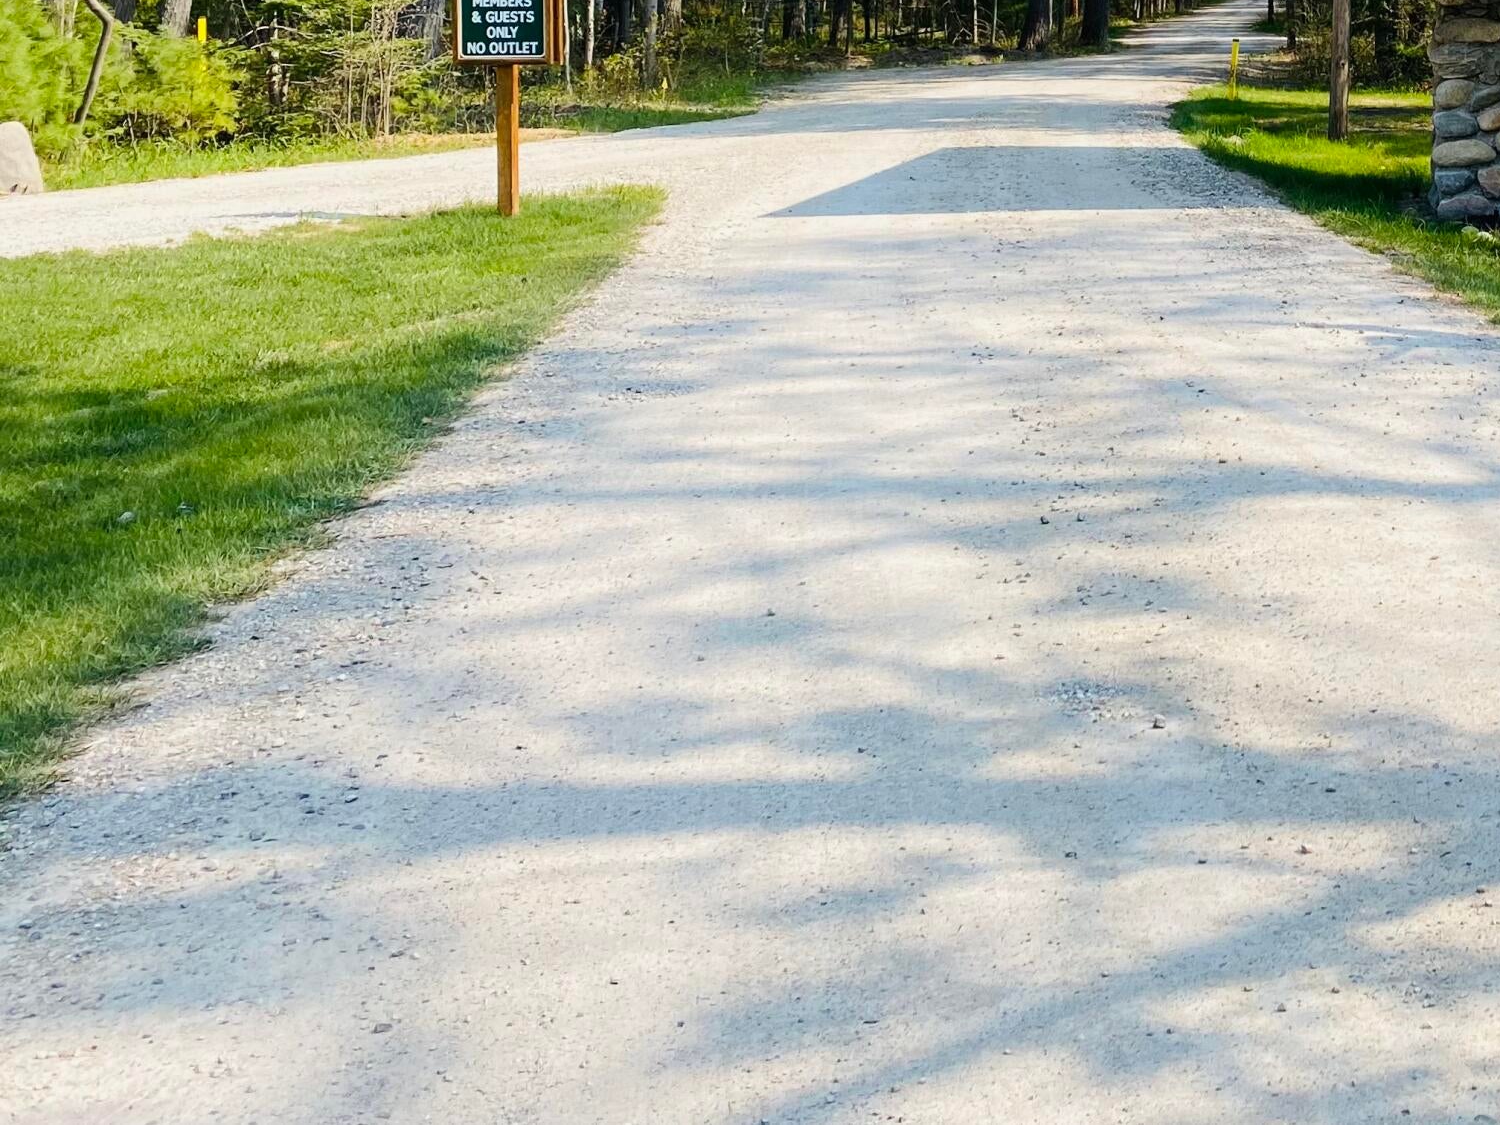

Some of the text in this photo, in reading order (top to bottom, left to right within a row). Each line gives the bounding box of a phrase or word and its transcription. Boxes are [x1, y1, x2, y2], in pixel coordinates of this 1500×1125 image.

[471, 11, 535, 23] & GUESTS
[486, 26, 519, 39] ONLY
[466, 42, 538, 54] NO OUTLET
